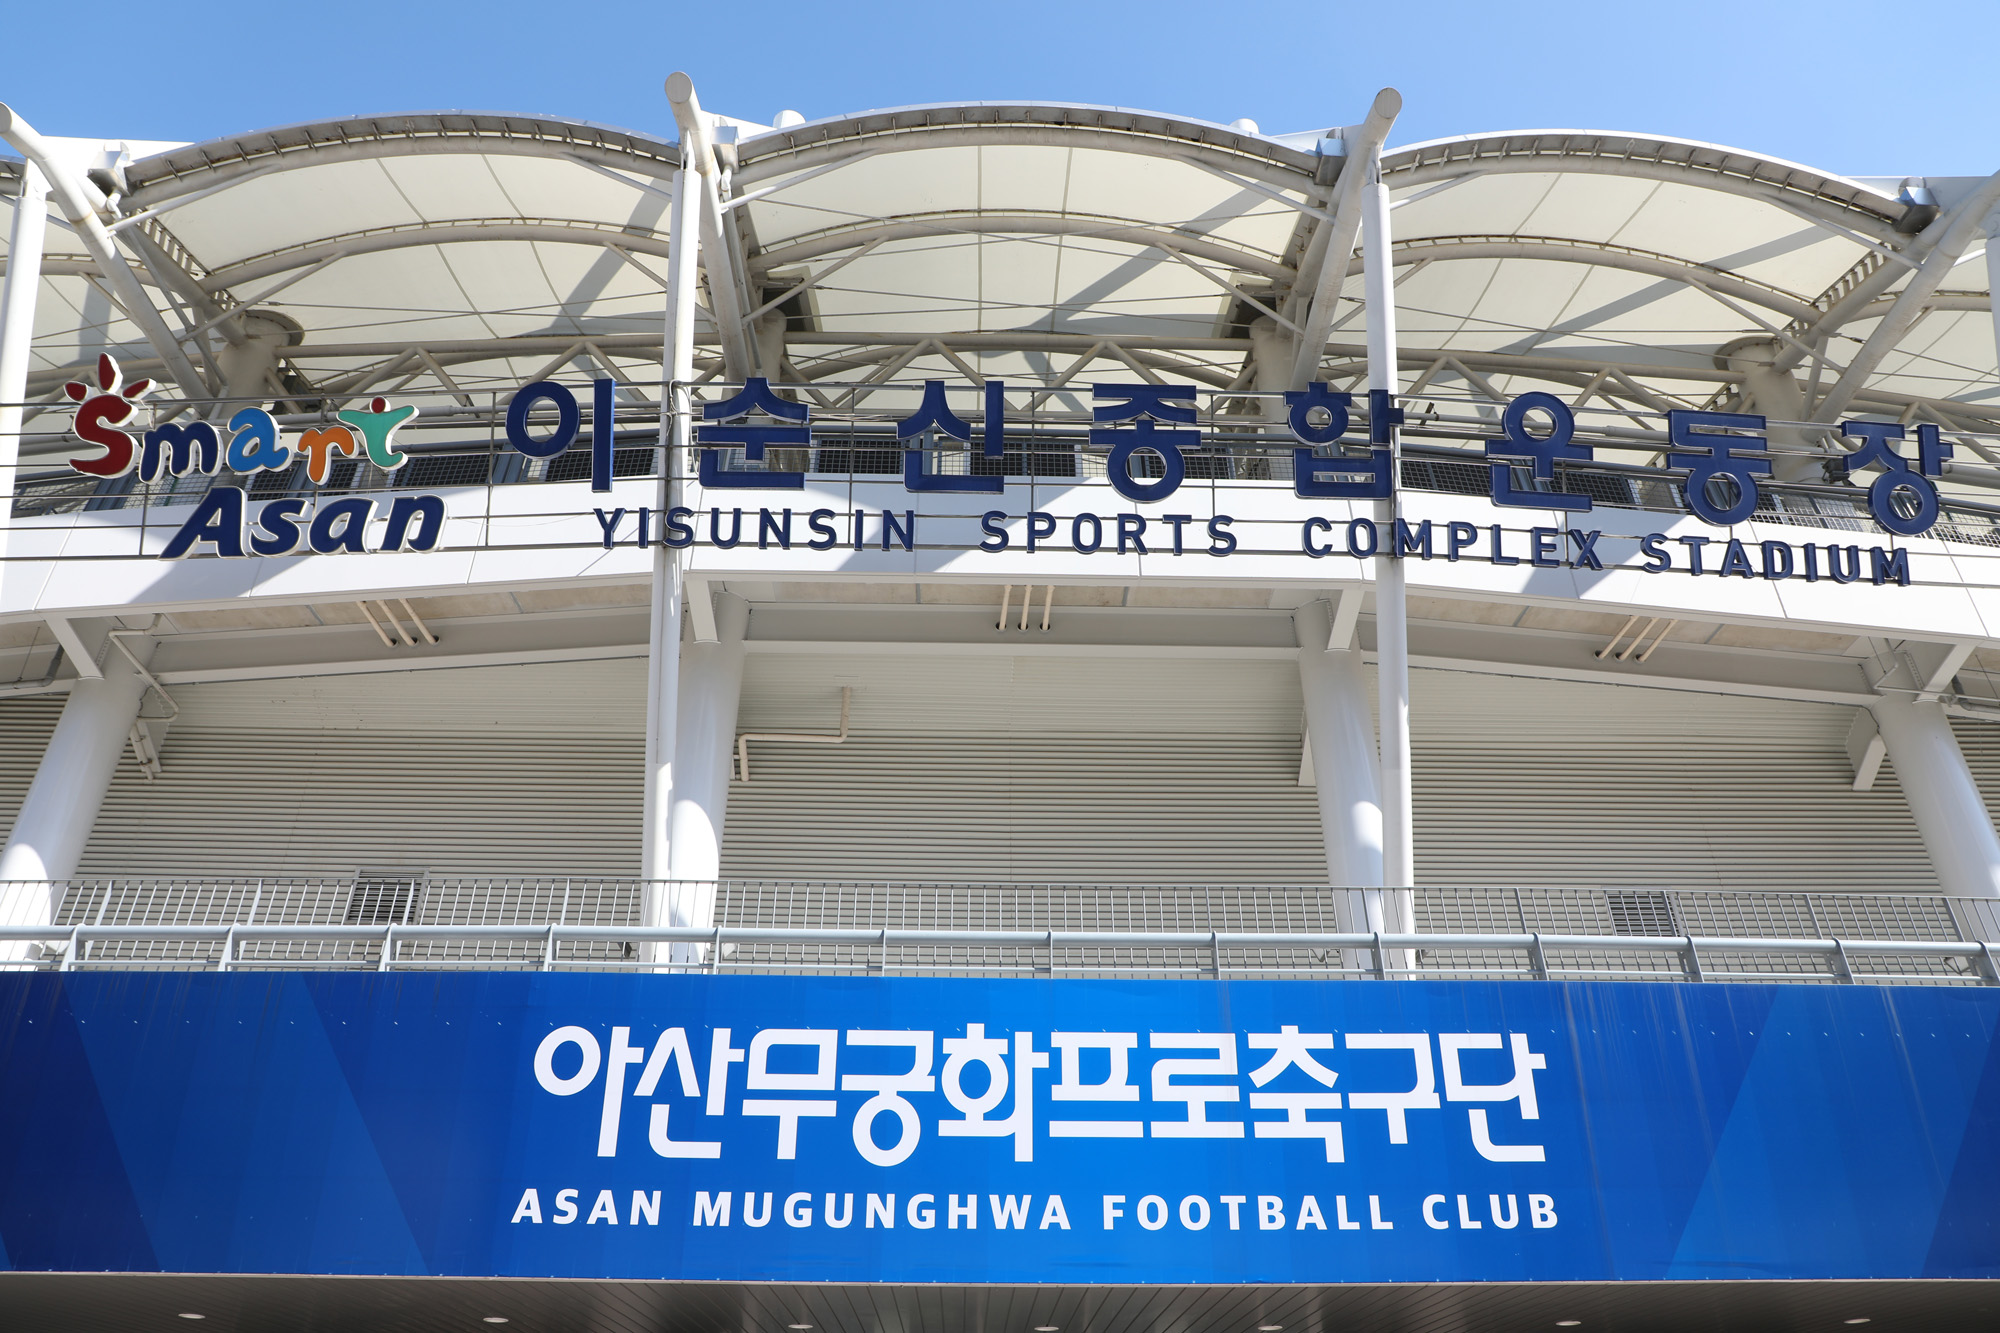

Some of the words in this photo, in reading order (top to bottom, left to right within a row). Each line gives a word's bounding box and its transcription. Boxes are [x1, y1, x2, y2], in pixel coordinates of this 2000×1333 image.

[64, 353, 420, 485] Smart
[157, 486, 448, 560] Asan
[593, 506, 915, 552] YISUNSIN
[979, 510, 1238, 556] SPORTS
[1302, 516, 1604, 571] COMPLEX
[1640, 533, 1910, 587] STADIUM
[533, 1023, 1547, 1167] 아산무궁화프로축구단
[511, 1188, 662, 1226] ASAN
[692, 1191, 1071, 1231] MUGUNGHWA
[1102, 1194, 1394, 1231] FOOTBALL
[1422, 1193, 1559, 1230] CLUB
